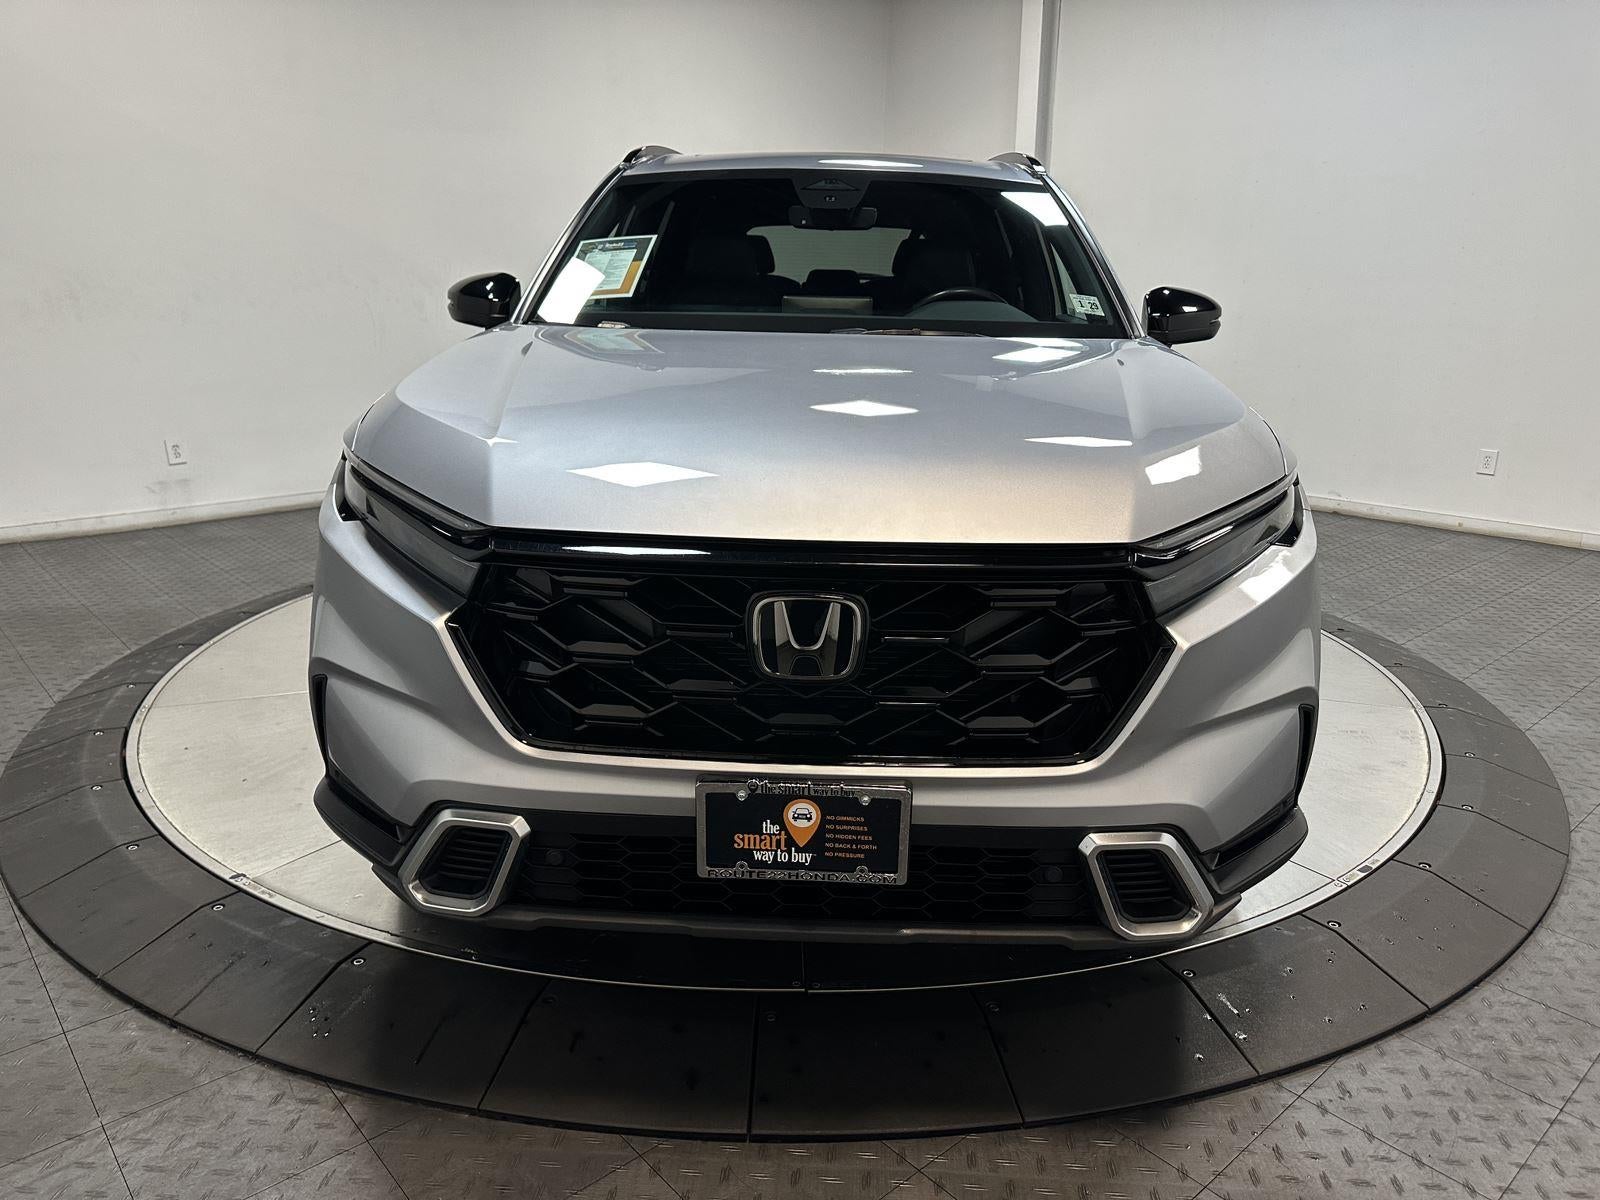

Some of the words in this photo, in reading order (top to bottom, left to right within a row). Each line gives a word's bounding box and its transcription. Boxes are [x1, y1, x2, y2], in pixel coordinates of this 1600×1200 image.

[761, 782, 776, 794] the
[778, 782, 811, 796] smart
[762, 820, 780, 834] the
[734, 831, 788, 850] smart
[753, 850, 775, 864] way
[777, 849, 789, 862] to
[791, 847, 812, 866] buy
